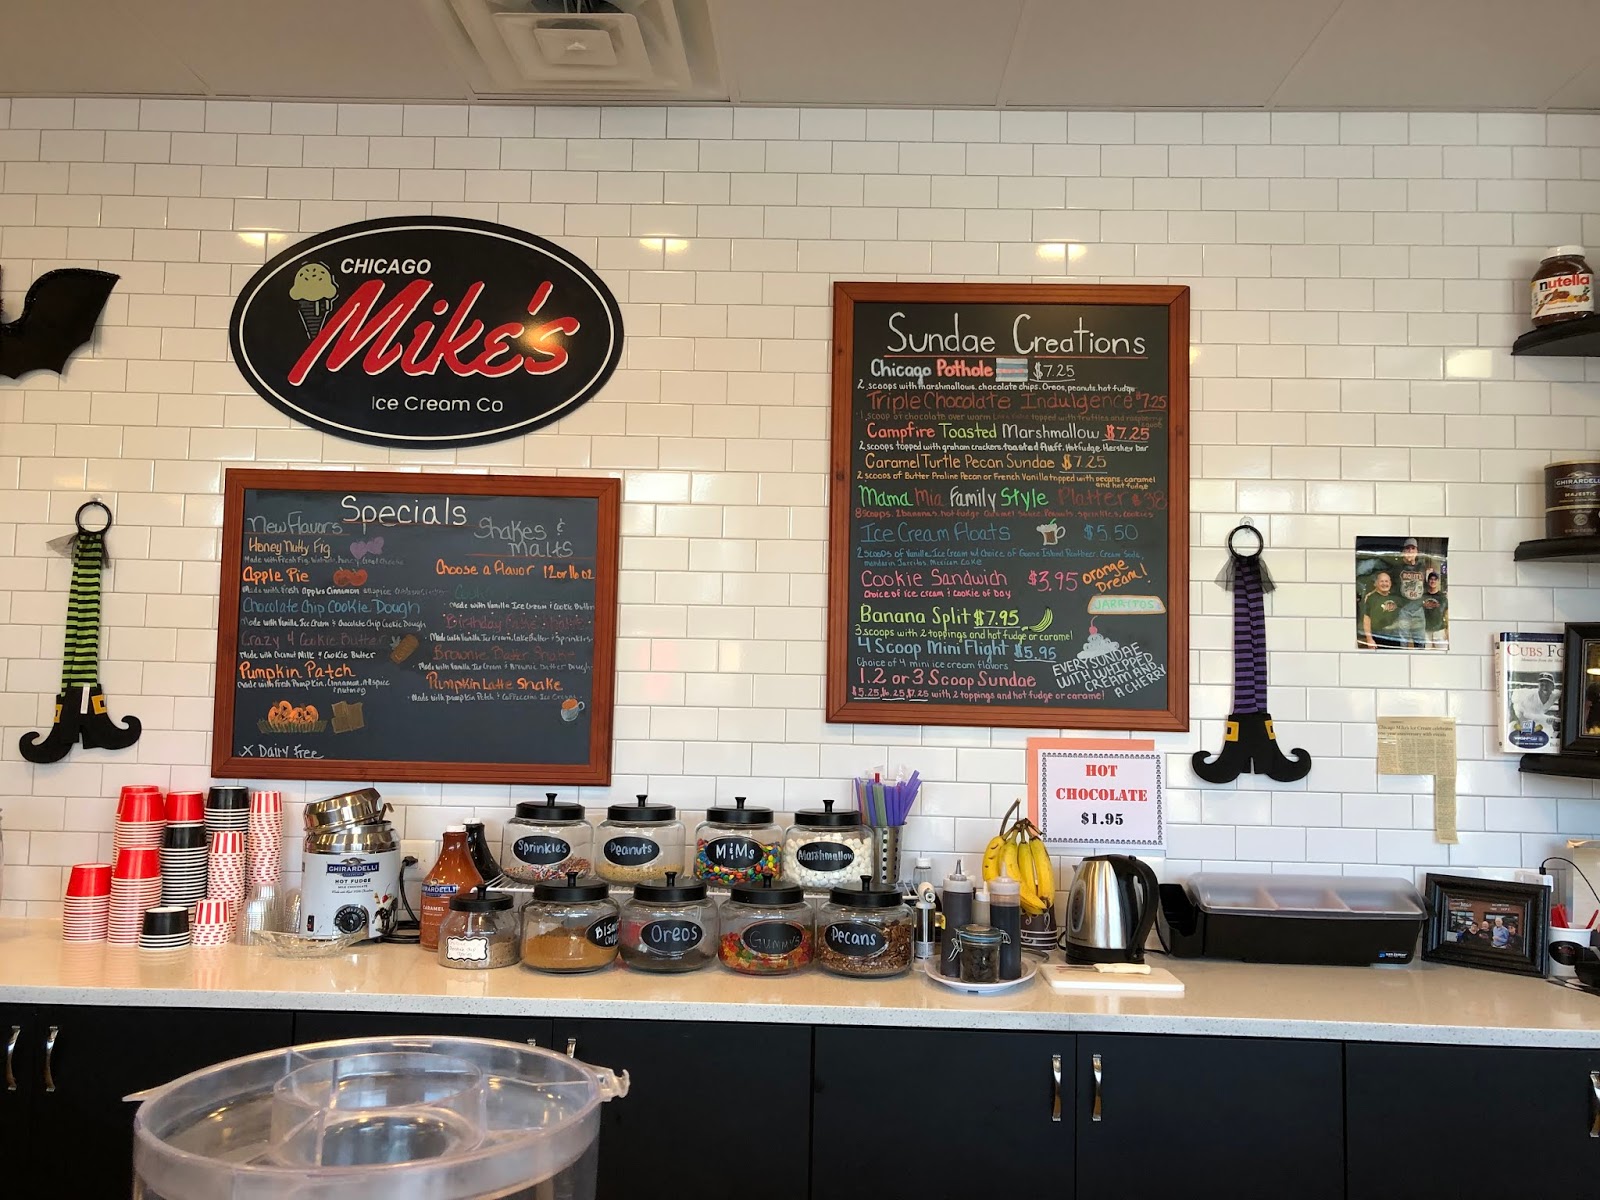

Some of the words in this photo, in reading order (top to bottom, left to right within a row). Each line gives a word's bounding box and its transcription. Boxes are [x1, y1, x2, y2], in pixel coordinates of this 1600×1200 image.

[341, 258, 431, 275] CHICAGO
[1540, 273, 1590, 290] nutella
[287, 279, 580, 386] Mike's
[887, 312, 996, 353] Sundae
[1013, 314, 1146, 355] Creations
[870, 358, 932, 386] Chicago
[937, 358, 994, 378] Pothole
[1033, 362, 1075, 380] $7.25
[899, 381, 917, 390] with
[978, 382, 1017, 391] chocolate
[372, 396, 398, 411] Ice
[404, 396, 469, 412] Cream
[475, 397, 503, 412] Co
[866, 391, 921, 414] Triple
[924, 391, 1011, 410] Chocolate
[1021, 392, 1133, 414] Indulgence
[905, 411, 945, 420] chocolate
[867, 421, 935, 443] Campfire
[938, 423, 997, 439] Toasted
[1002, 423, 1100, 439] Marshmallow
[1104, 424, 1150, 440] $7.25
[897, 441, 922, 452] topped
[923, 443, 941, 451] with
[942, 443, 970, 453] graham
[865, 452, 920, 469] Caramel
[921, 454, 961, 469] Turtle
[965, 454, 1003, 469] Pecan
[1006, 453, 1055, 469] Sundae
[865, 472, 891, 480] scoops
[905, 472, 930, 480] Butter
[932, 472, 958, 480] Praline
[960, 472, 981, 480] Pecan
[993, 473, 1020, 481] French
[1021, 473, 1049, 481] Vanilla
[1124, 476, 1156, 484] caramel
[858, 484, 914, 507] Mama
[914, 488, 944, 507] Mia
[950, 485, 997, 512] Family
[1001, 487, 1049, 511] Style
[288, 511, 343, 535] Flavors
[341, 495, 467, 535] Specials
[474, 516, 547, 542] Shakes
[860, 522, 896, 542] Ice
[898, 521, 949, 542] Cream
[954, 521, 1011, 541] Floats
[1084, 524, 1138, 541] $5.50
[249, 537, 282, 555] Honey
[285, 540, 309, 557] Nutty
[313, 537, 331, 559] Fig
[508, 541, 573, 559] Malts
[243, 566, 283, 586] Apple
[288, 567, 310, 583] Pie
[436, 558, 479, 576] Choose
[861, 569, 924, 587] Cookie
[931, 568, 1009, 588] Sandwich
[1027, 570, 1078, 592] $3.95
[243, 597, 299, 614] Chocolate
[301, 599, 325, 617] Chip
[328, 599, 371, 614] Cookie
[372, 598, 420, 618] Dough
[1094, 599, 1155, 610] JARRITOS
[860, 604, 926, 624] Banana
[932, 606, 971, 630] Split
[973, 609, 1020, 627] $7.95
[897, 628, 918, 638] with
[928, 630, 967, 642] toppings
[969, 630, 986, 639] and
[987, 629, 1001, 640] hot
[1003, 629, 1026, 643] fudge
[1039, 630, 1073, 642] caramel
[323, 651, 349, 660] Cookie
[351, 651, 377, 660] Butter
[858, 637, 871, 652] 4
[875, 638, 922, 660] Scoop
[927, 640, 961, 655] Mini
[964, 639, 1009, 663] Flight
[1014, 643, 1057, 660] $5.95
[1052, 658, 1089, 676] EVERY
[1090, 642, 1143, 670] SUNDAE
[239, 660, 303, 683] Pumpkin
[305, 660, 356, 681] Patch
[857, 656, 886, 667] Choice
[899, 658, 906, 667] 4
[910, 659, 930, 668] mini
[931, 660, 945, 669] ice
[946, 662, 975, 670] cream
[977, 660, 1009, 671] flavors
[1056, 670, 1092, 689] WITH
[1093, 652, 1153, 680] WHIPPED
[426, 671, 481, 694] Pumpkin
[482, 677, 513, 690] Latte
[517, 677, 563, 691] Shake
[892, 675, 909, 686] or
[912, 668, 924, 686] 3
[928, 669, 974, 690] Scoop
[977, 670, 1037, 688] Sundae
[1084, 670, 1131, 692] CREAM
[1133, 661, 1157, 678] AND
[1114, 687, 1125, 698] A
[1124, 663, 1167, 694] CHERRY
[931, 690, 951, 699] with
[953, 690, 959, 699] 2
[960, 691, 994, 703] toppings
[997, 691, 1012, 699] and
[1012, 691, 1026, 700] hot
[1028, 691, 1053, 703] fudge
[1067, 690, 1105, 700] caramel
[258, 743, 289, 759] Dairy
[294, 744, 325, 760] Free
[1086, 764, 1118, 777] HOT
[1055, 787, 1148, 802] CHOCOLATE
[1081, 812, 1124, 826] $1.95
[517, 838, 567, 856] Sprinkles
[610, 840, 652, 856] Peanuts
[651, 926, 698, 942] Oreos
[832, 926, 877, 945] Pecans
